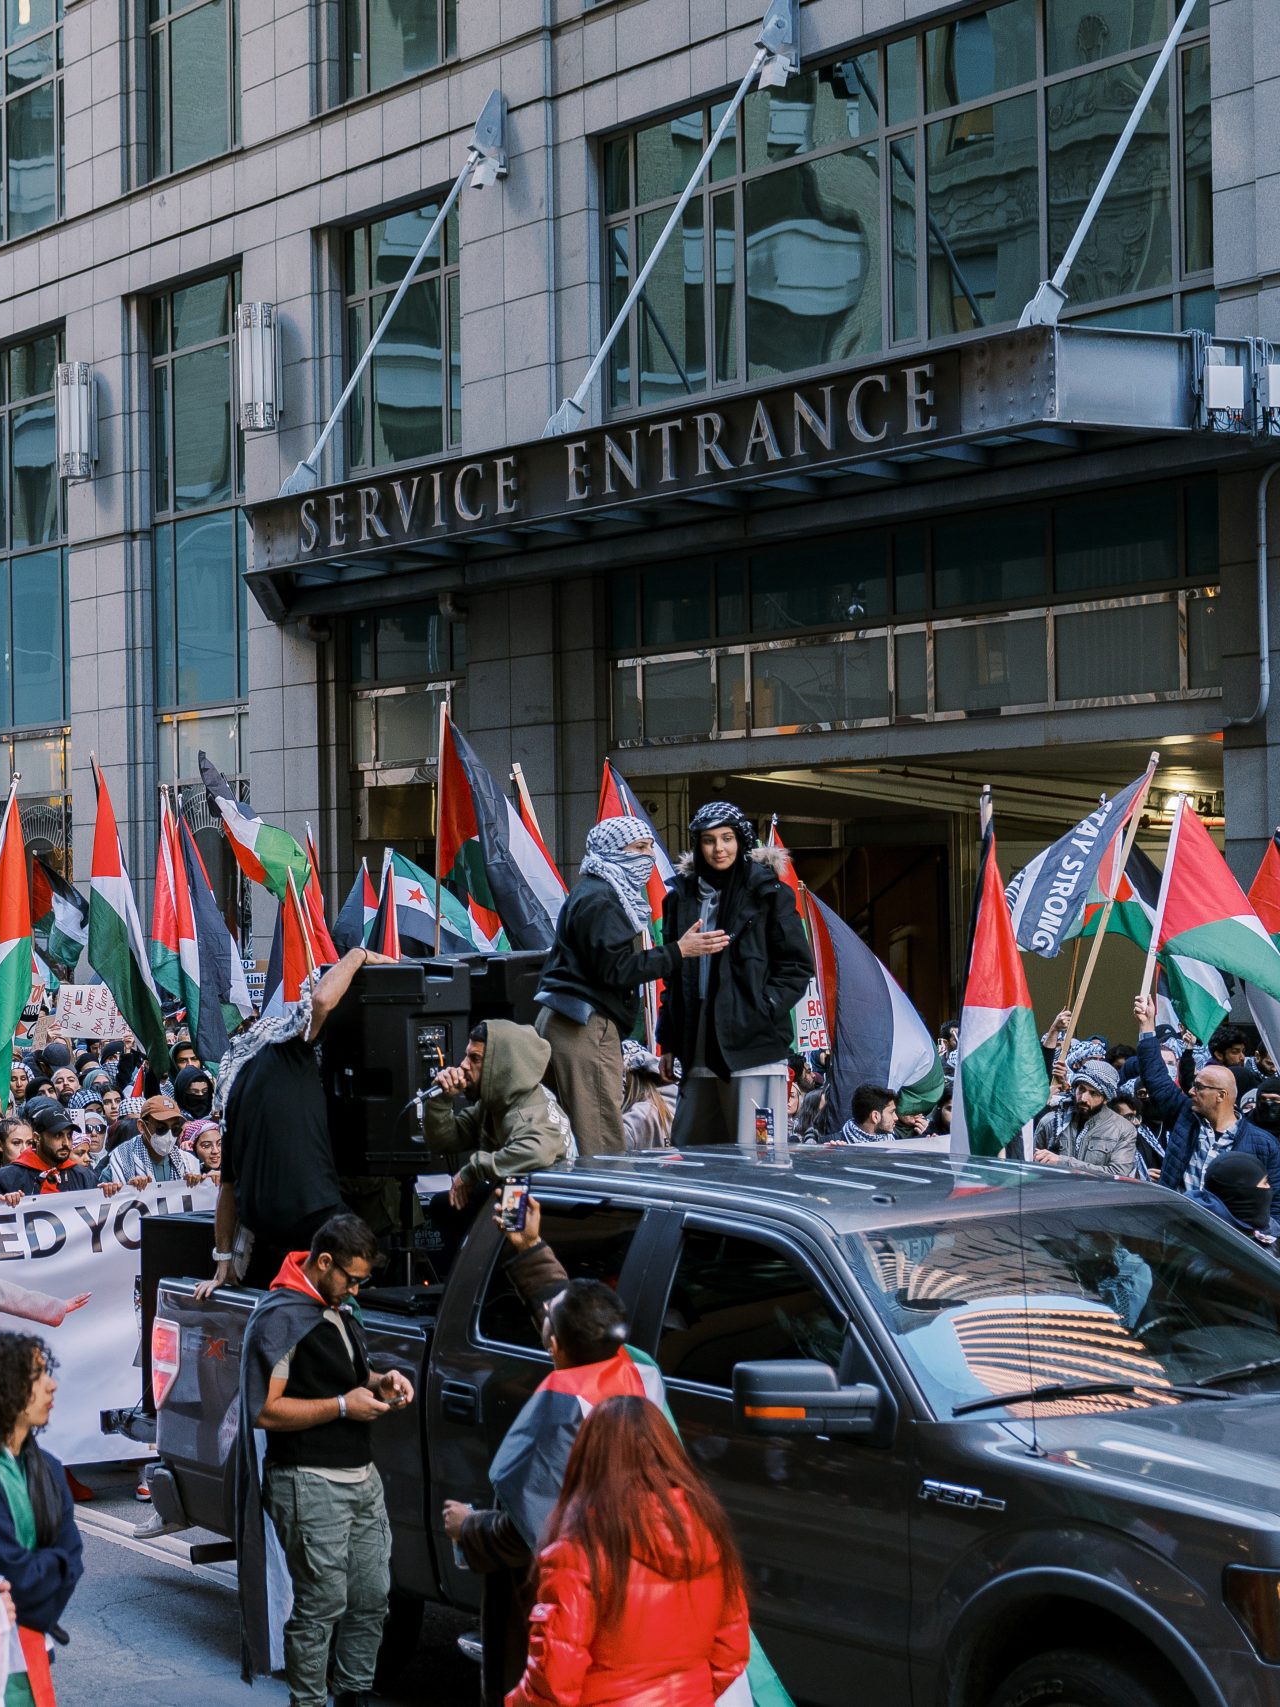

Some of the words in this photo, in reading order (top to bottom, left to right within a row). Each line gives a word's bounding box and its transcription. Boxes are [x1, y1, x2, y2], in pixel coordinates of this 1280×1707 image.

[299, 454, 519, 554] SERVICE
[565, 362, 939, 502] ENTRANCE
[1070, 800, 1113, 855] STAY
[1032, 854, 1085, 952] STRONG
